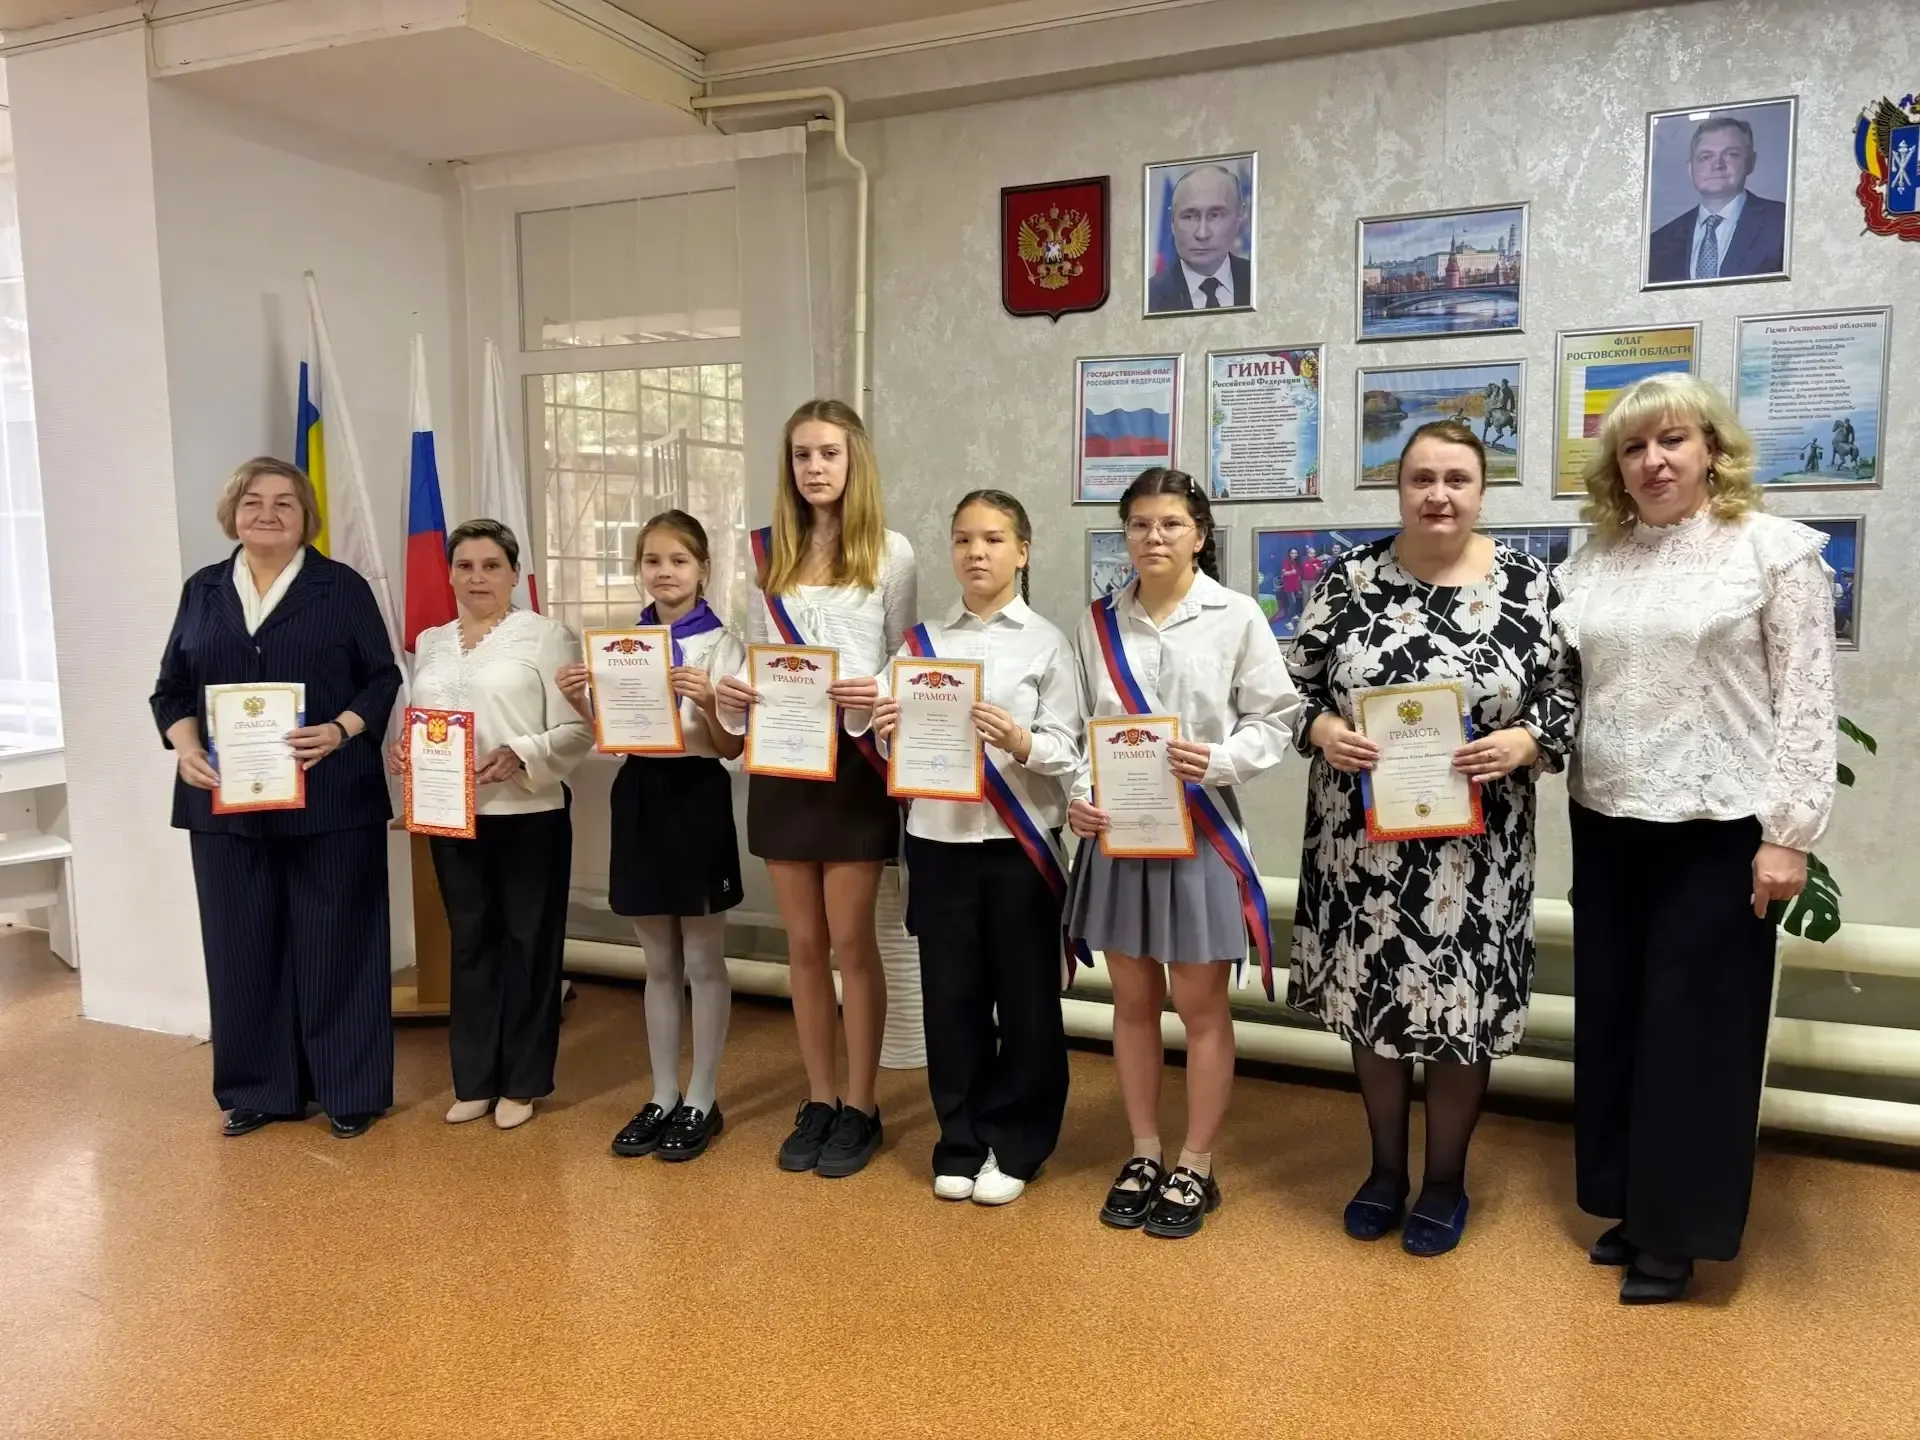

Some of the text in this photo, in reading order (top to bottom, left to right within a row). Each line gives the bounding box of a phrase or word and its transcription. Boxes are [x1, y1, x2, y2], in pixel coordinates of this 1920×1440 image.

[1839, 321, 1877, 329] области
[1614, 336, 1643, 345] ФЛАГ
[1566, 345, 1691, 360] РОСТОВСКОЙ ОБЛАСТИ
[1087, 368, 1151, 378] ГОСУДАРСТВЕННЫЙ
[1227, 361, 1286, 378] ГИМН
[1086, 377, 1171, 387] РОССИЙСКОЙ ФЕДЕРАЦИИ
[1212, 377, 1301, 388] Российской Федерации
[608, 658, 650, 666] ГРАМОТА
[772, 674, 815, 685] ГРАМОТА
[913, 692, 958, 702] ГРАМОТА
[234, 719, 278, 729] ГРАМОТА
[1388, 727, 1441, 740] ГРАМОТА
[1113, 750, 1156, 760] ГРАМОТА
